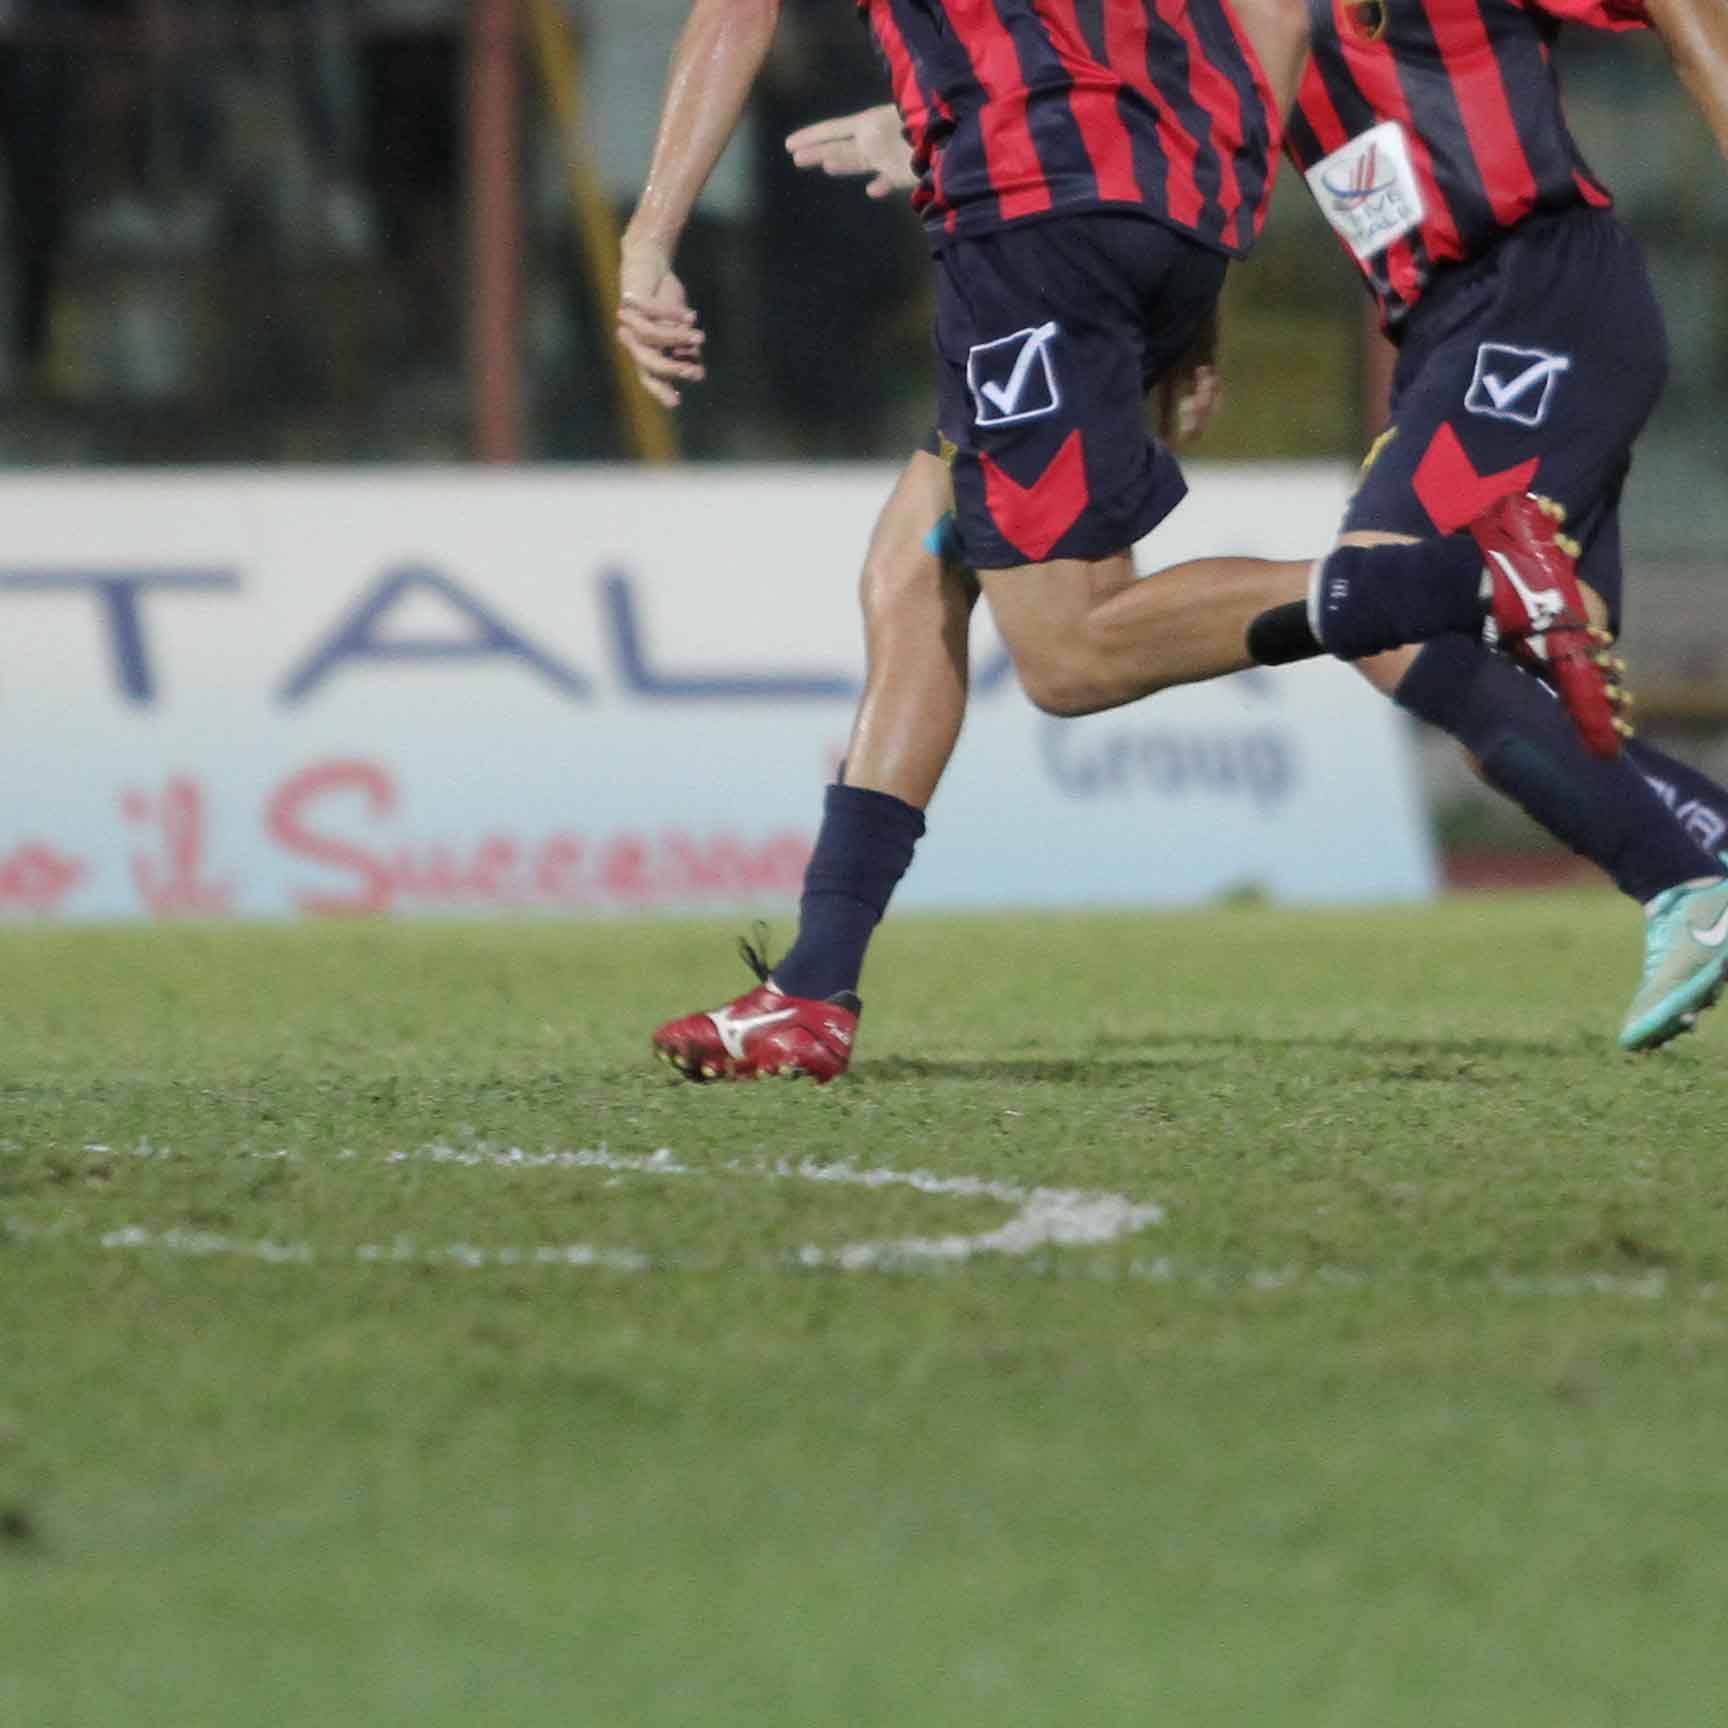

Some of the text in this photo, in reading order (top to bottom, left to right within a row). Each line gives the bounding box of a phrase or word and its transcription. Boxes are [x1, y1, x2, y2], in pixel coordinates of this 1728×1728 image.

[1039, 712, 1297, 812] Group
[115, 772, 237, 918] il
[262, 756, 846, 918] Successo
